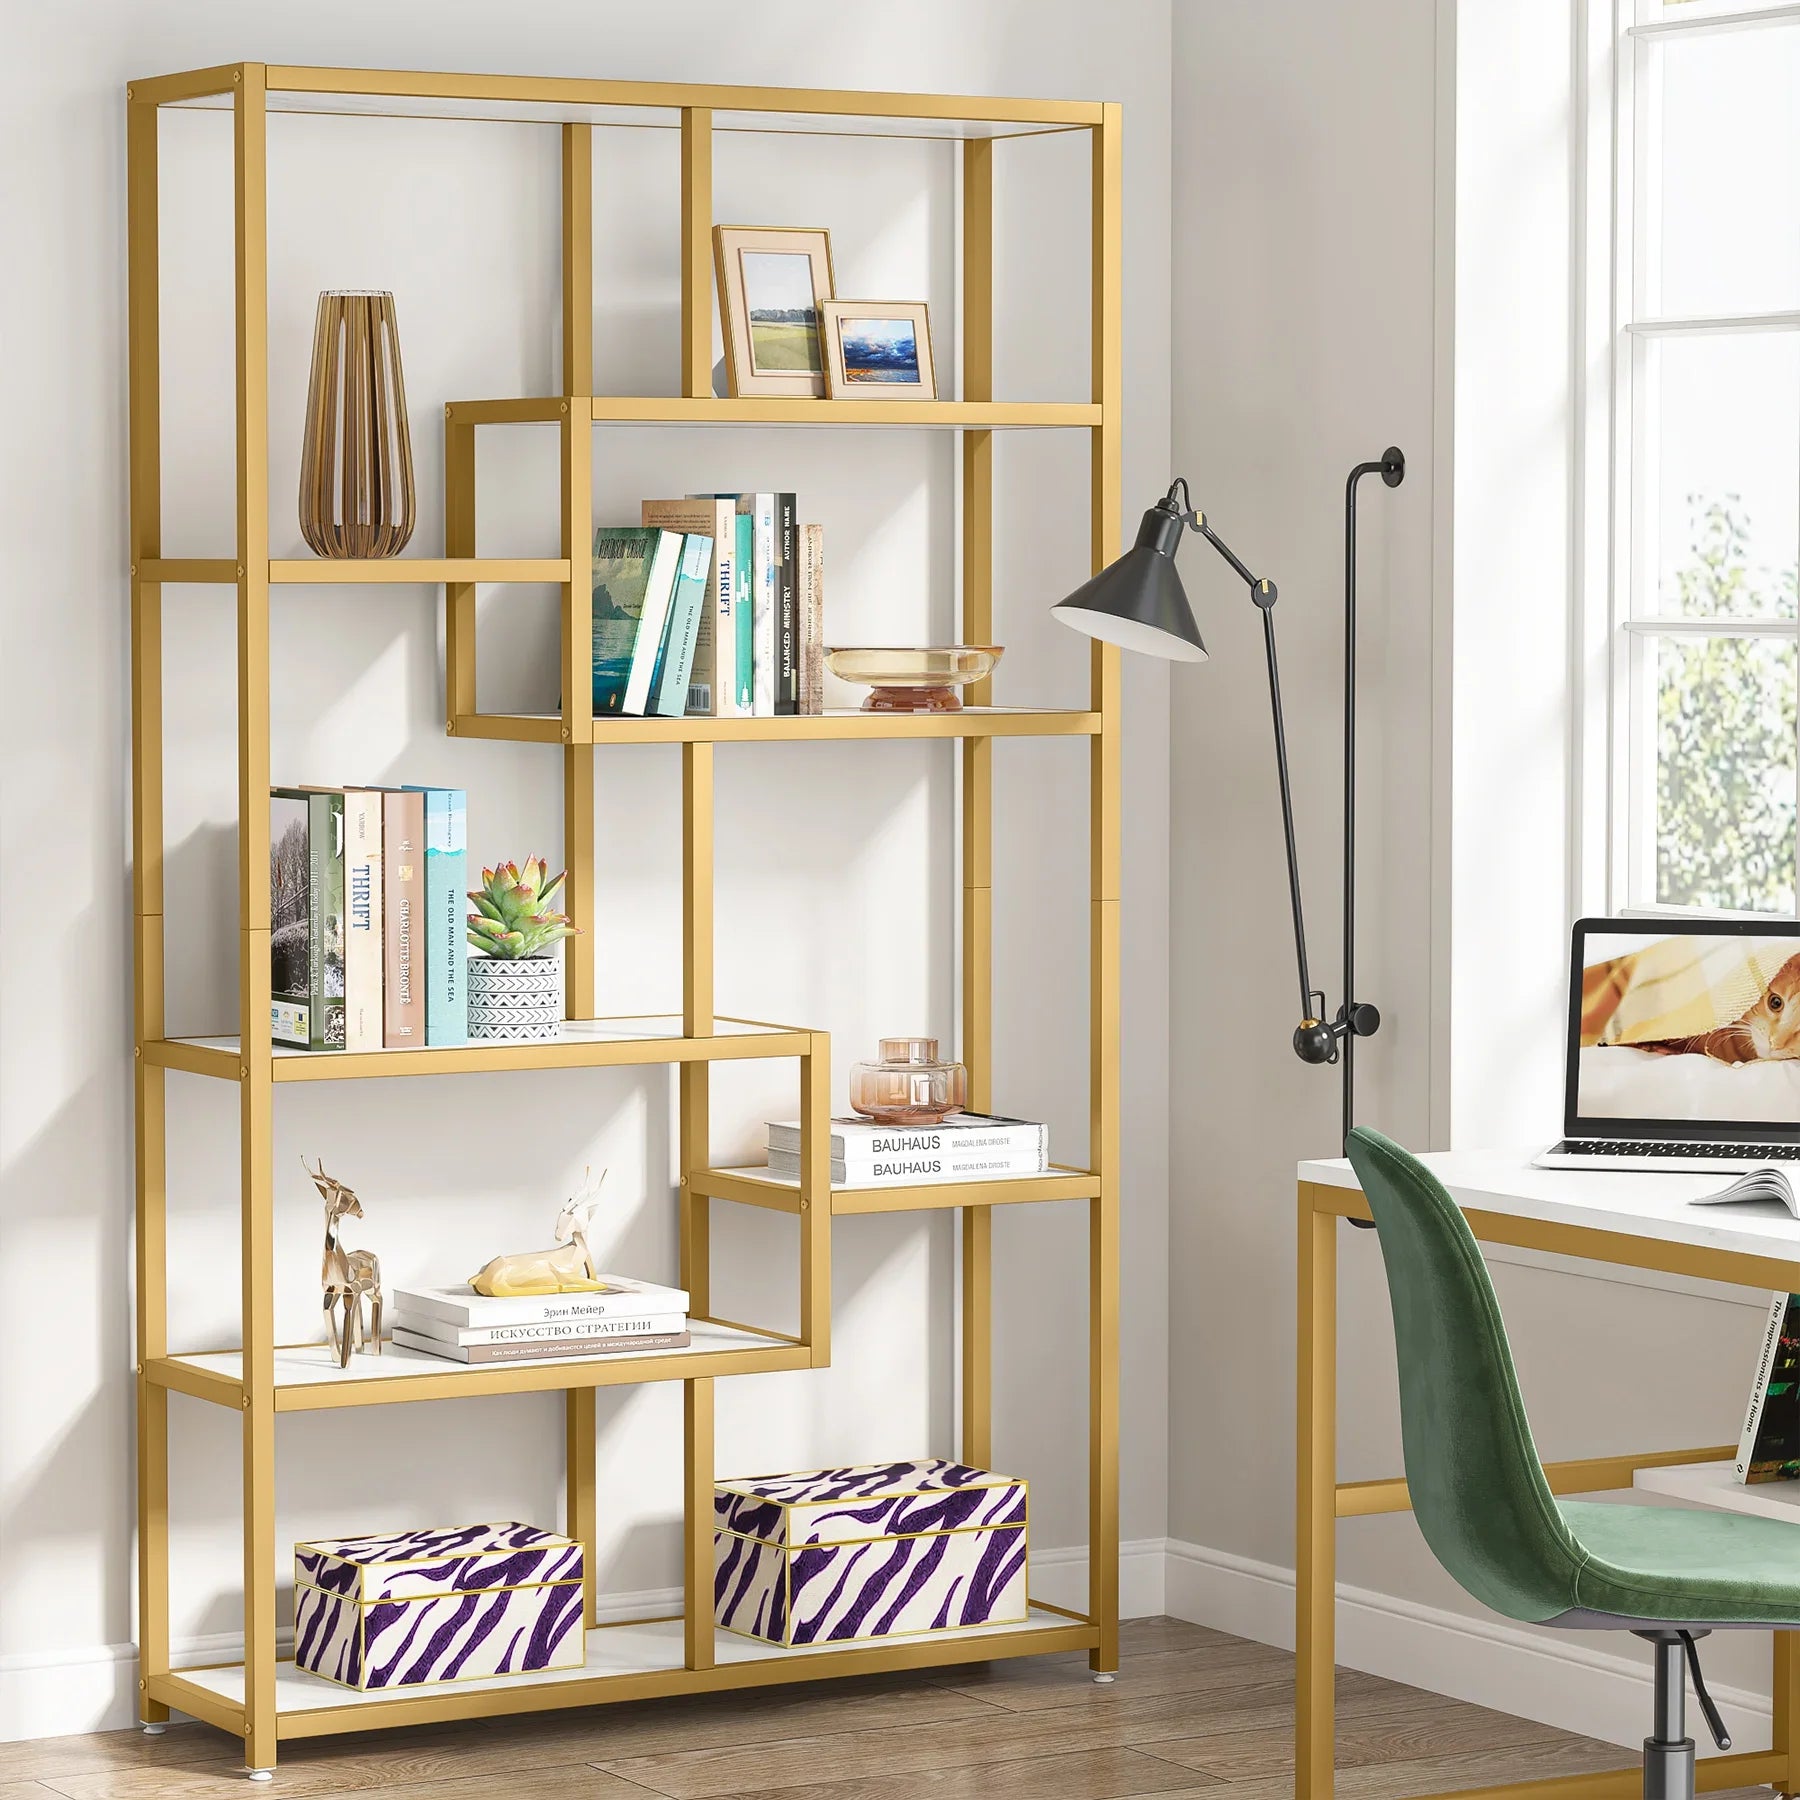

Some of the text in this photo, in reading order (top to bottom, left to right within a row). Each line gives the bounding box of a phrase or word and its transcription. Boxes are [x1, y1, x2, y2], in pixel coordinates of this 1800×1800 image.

[720, 560, 730, 616] THRIFT
[783, 585, 791, 678] BALANCED MINISTRY
[310, 887, 321, 905] Today
[353, 865, 370, 931] THRIFT
[310, 912, 321, 941] Yesterday
[399, 899, 410, 962] CHARLOTTE
[872, 1135, 1011, 1153] BAUHAUS MAGDALENA DROSTE
[873, 1160, 1011, 1176] BAUHAUS MAGDALENA DROSTE
[543, 1304, 605, 1318] Эрин Мейер
[490, 1321, 651, 1340] ИСКУССТВО СТРАТЕГИИ
[1746, 1300, 1783, 1433] The Impressionists at Home
